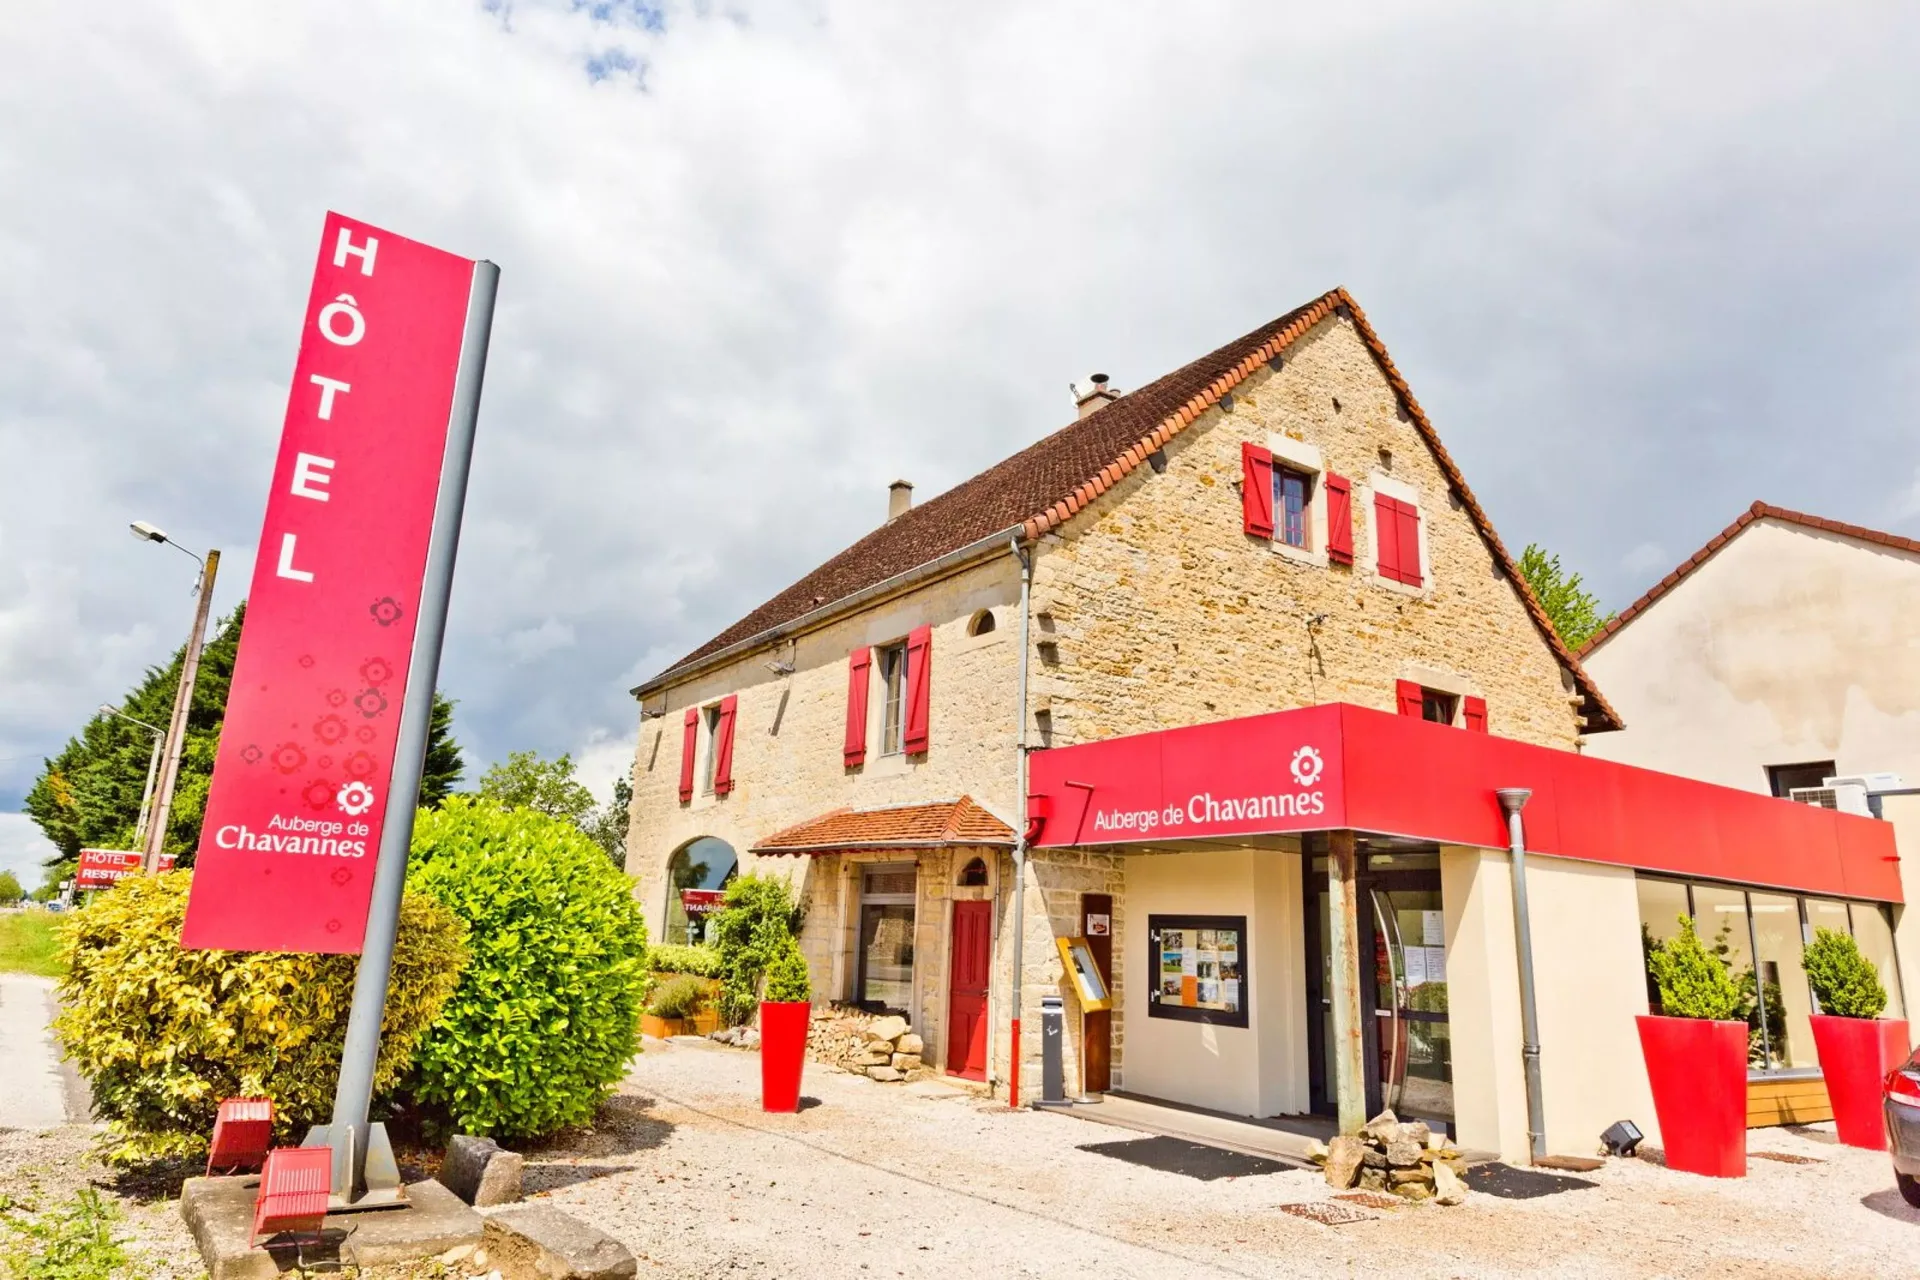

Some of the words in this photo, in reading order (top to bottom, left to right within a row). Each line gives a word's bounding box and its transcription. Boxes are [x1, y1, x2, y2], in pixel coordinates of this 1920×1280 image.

[276, 227, 378, 582] HÔTEL
[268, 814, 343, 836] Auberge
[347, 821, 369, 836] de
[1094, 810, 1158, 832] Auberge
[1162, 804, 1184, 825] de
[1188, 791, 1325, 823] Chavannes
[215, 825, 366, 858] Chavannes
